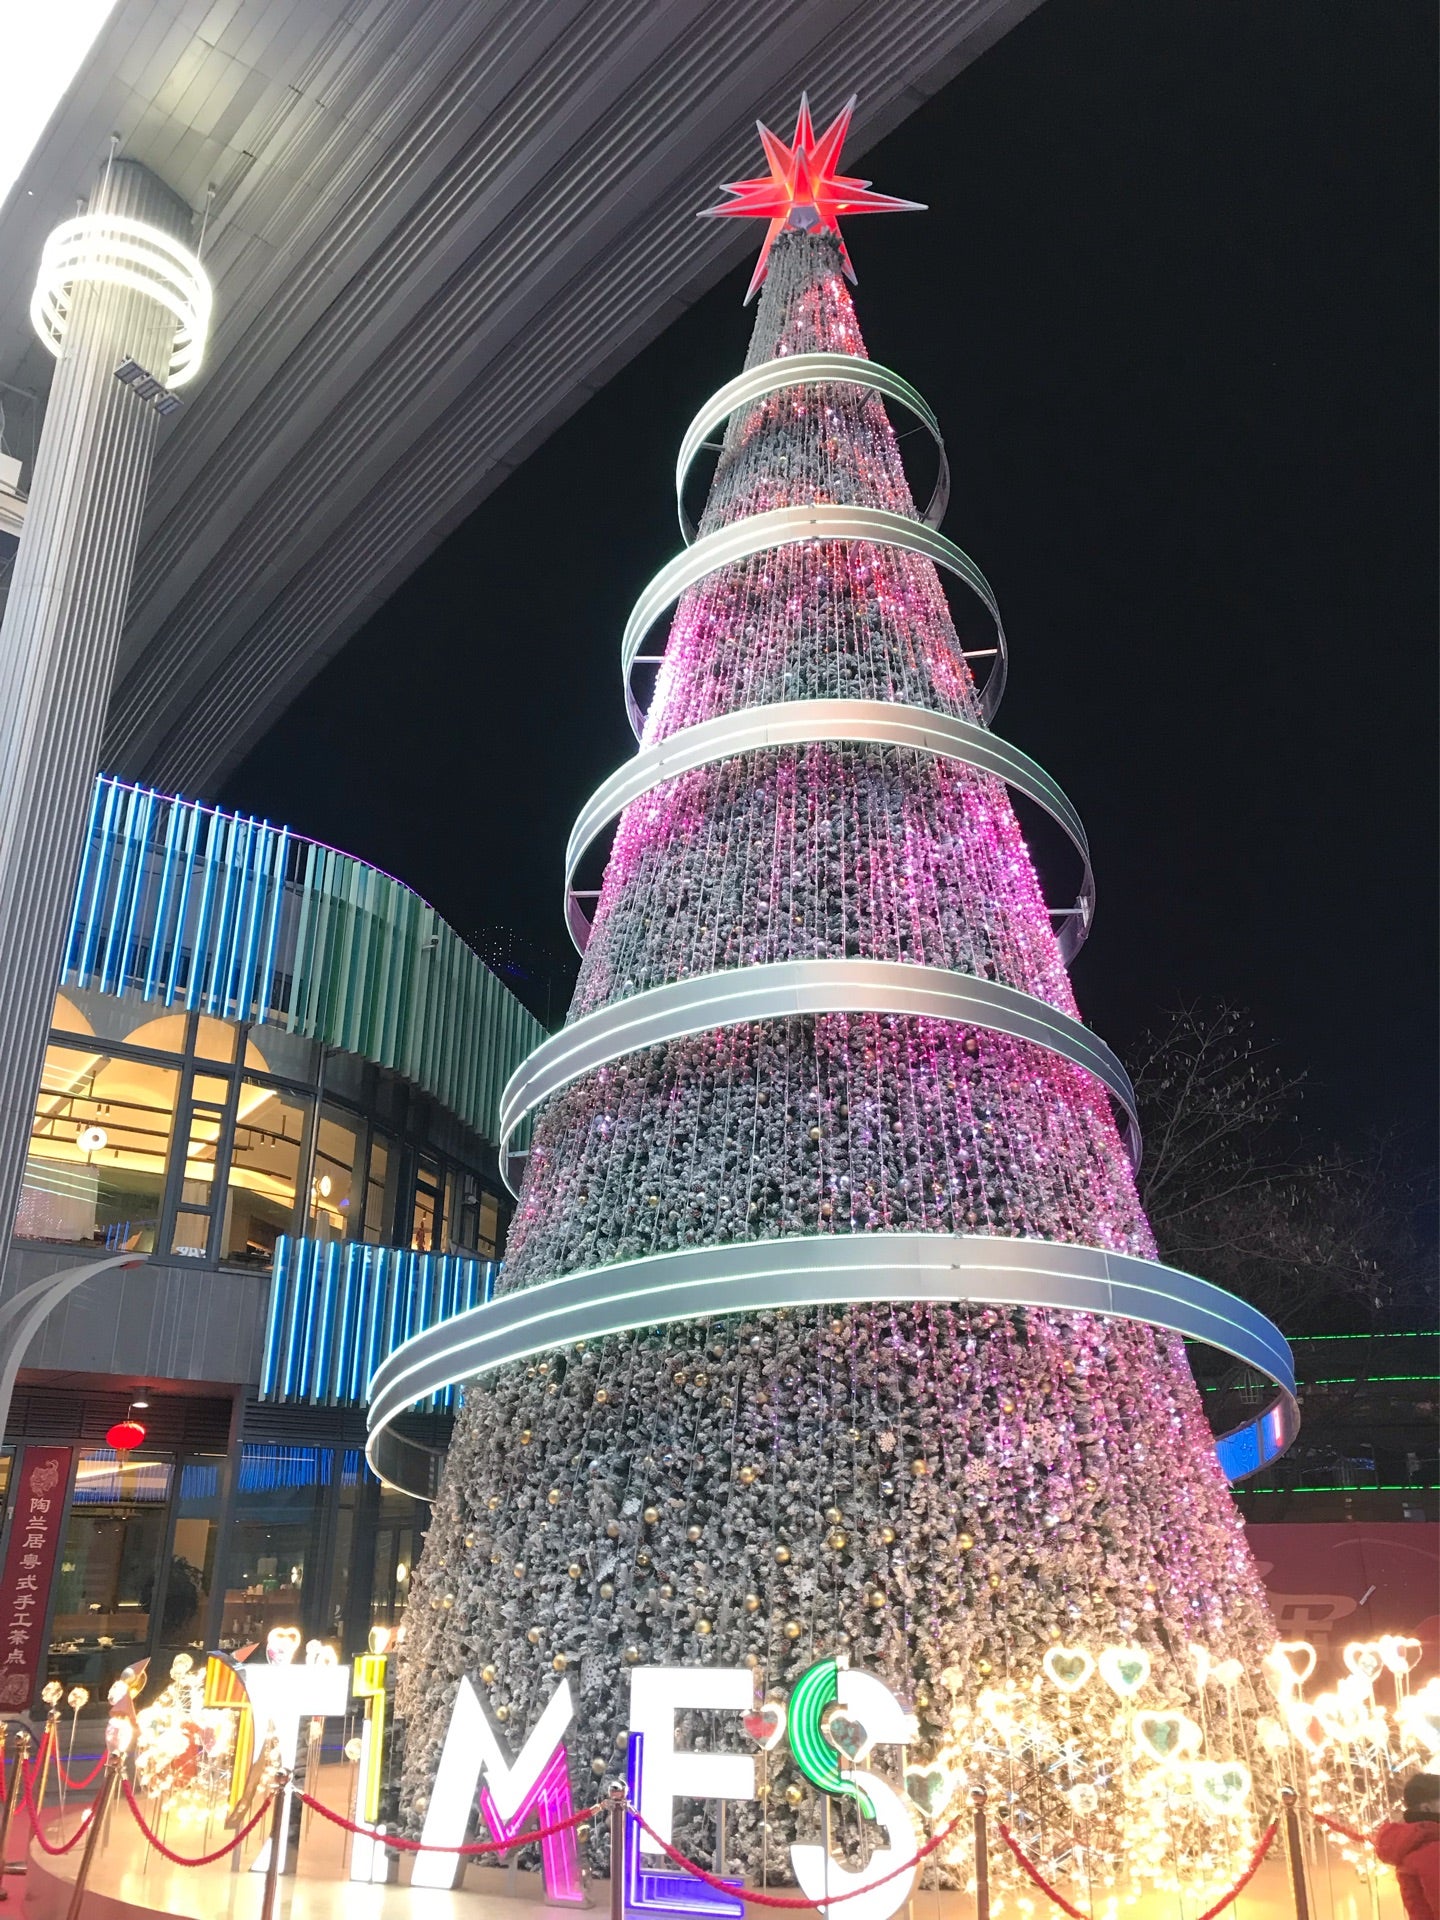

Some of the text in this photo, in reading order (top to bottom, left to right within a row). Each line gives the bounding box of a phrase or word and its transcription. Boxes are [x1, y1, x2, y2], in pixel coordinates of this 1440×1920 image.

[5, 1498, 51, 1664] 陶兰居粤式手工茶点
[205, 1654, 923, 1919] TIMES
